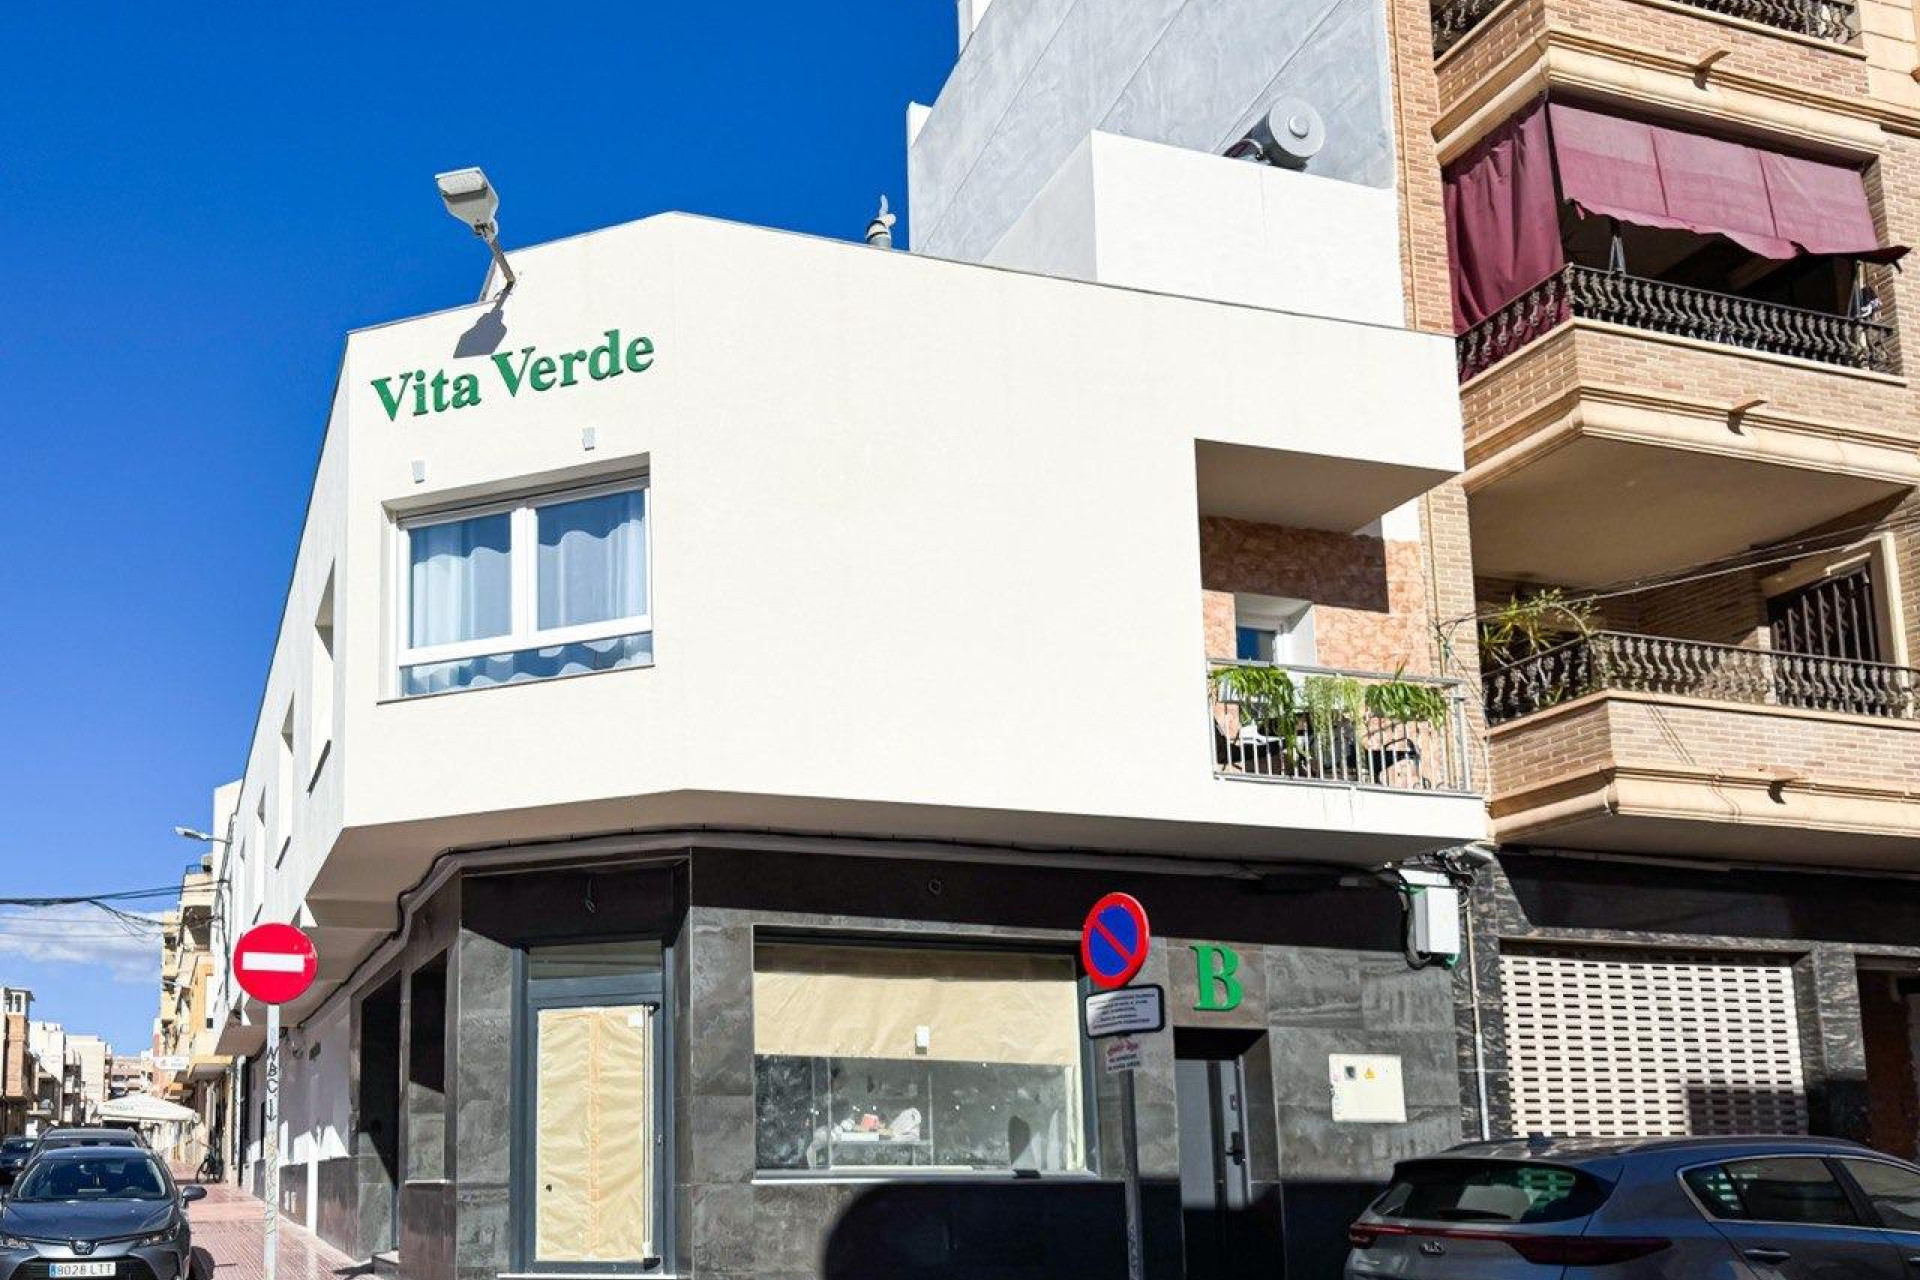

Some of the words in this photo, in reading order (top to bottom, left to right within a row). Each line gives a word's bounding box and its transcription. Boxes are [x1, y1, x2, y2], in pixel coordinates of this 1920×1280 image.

[370, 368, 482, 422] Vita
[490, 328, 655, 398] Verde
[1189, 944, 1243, 1011] B
